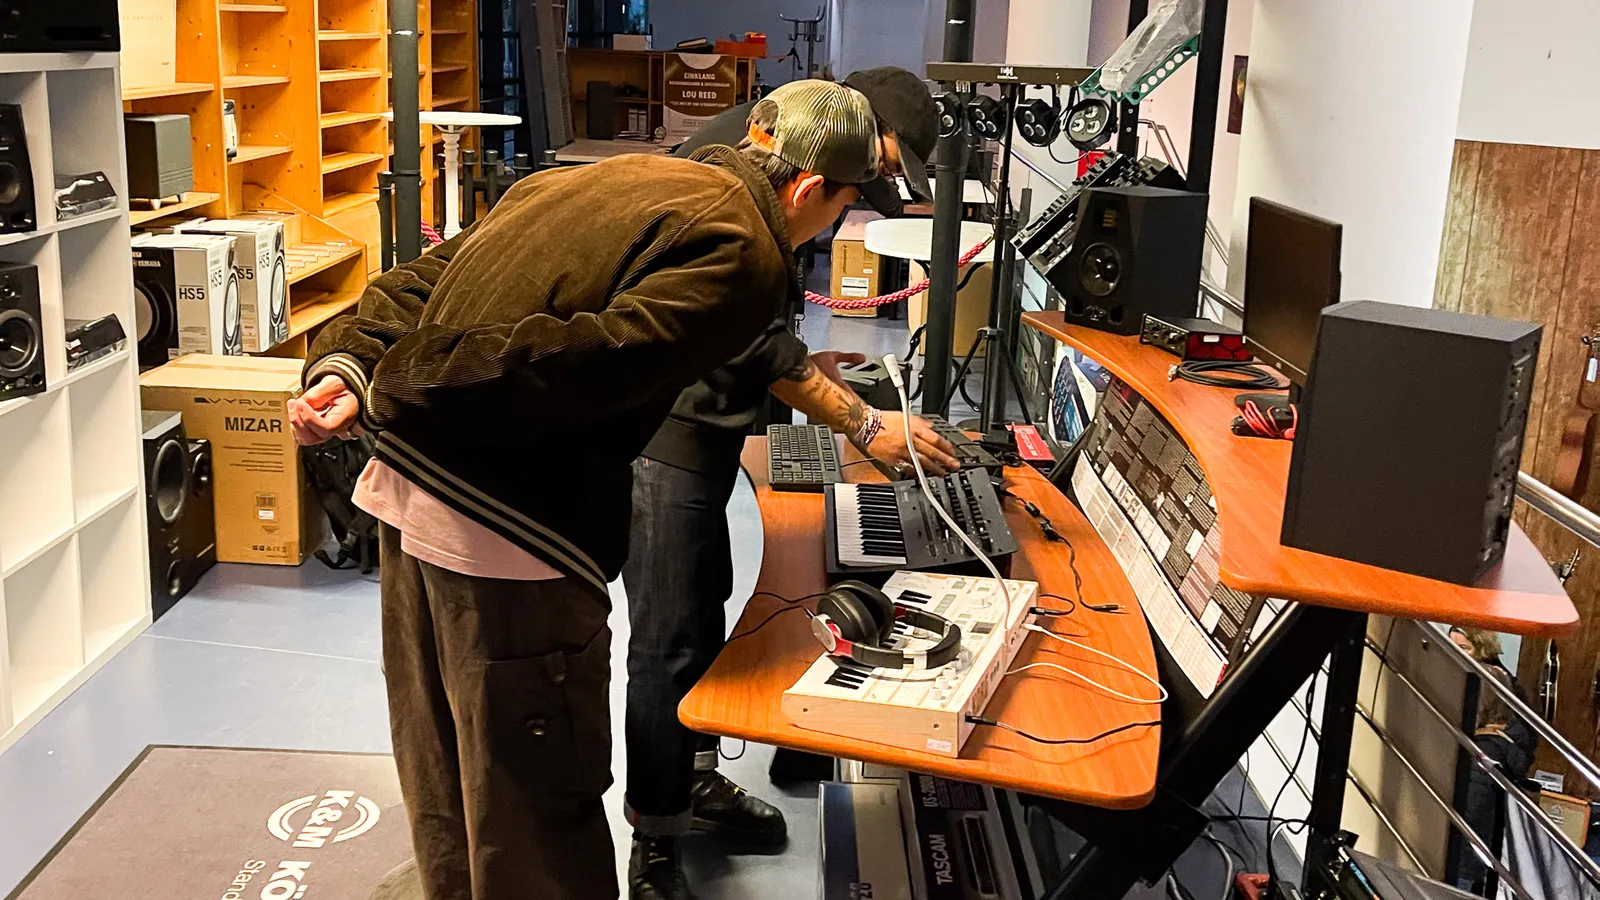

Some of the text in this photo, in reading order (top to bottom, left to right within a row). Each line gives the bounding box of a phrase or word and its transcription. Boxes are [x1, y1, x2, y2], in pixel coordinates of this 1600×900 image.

[684, 72, 715, 80] EINKLANG
[682, 90, 717, 99] LOU REED
[258, 252, 270, 269] HS5
[210, 269, 222, 290] HS5
[238, 268, 254, 280] S5
[179, 287, 205, 300] HS5
[224, 416, 282, 433] MIZAR
[292, 790, 355, 848] K&M
[928, 834, 953, 886] TASCAM
